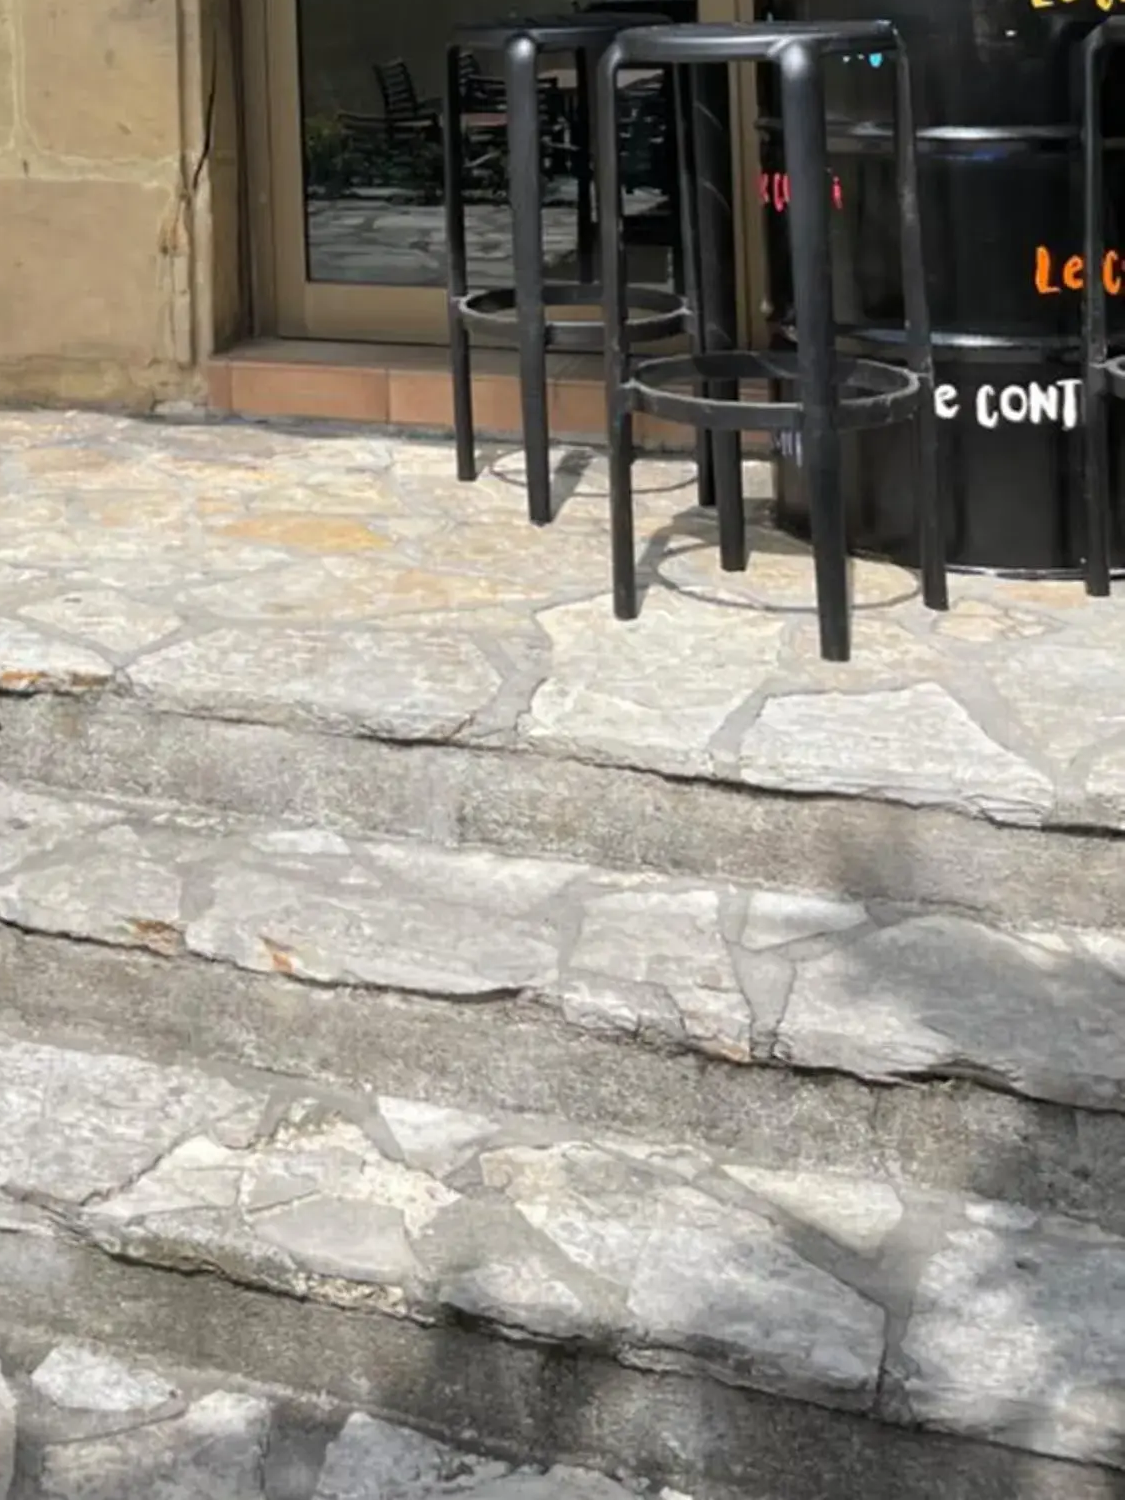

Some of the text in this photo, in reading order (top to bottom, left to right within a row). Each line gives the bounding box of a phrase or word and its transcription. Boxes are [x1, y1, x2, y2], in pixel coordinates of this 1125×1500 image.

[1035, 244, 1125, 296] Le C
[932, 382, 962, 420] e
